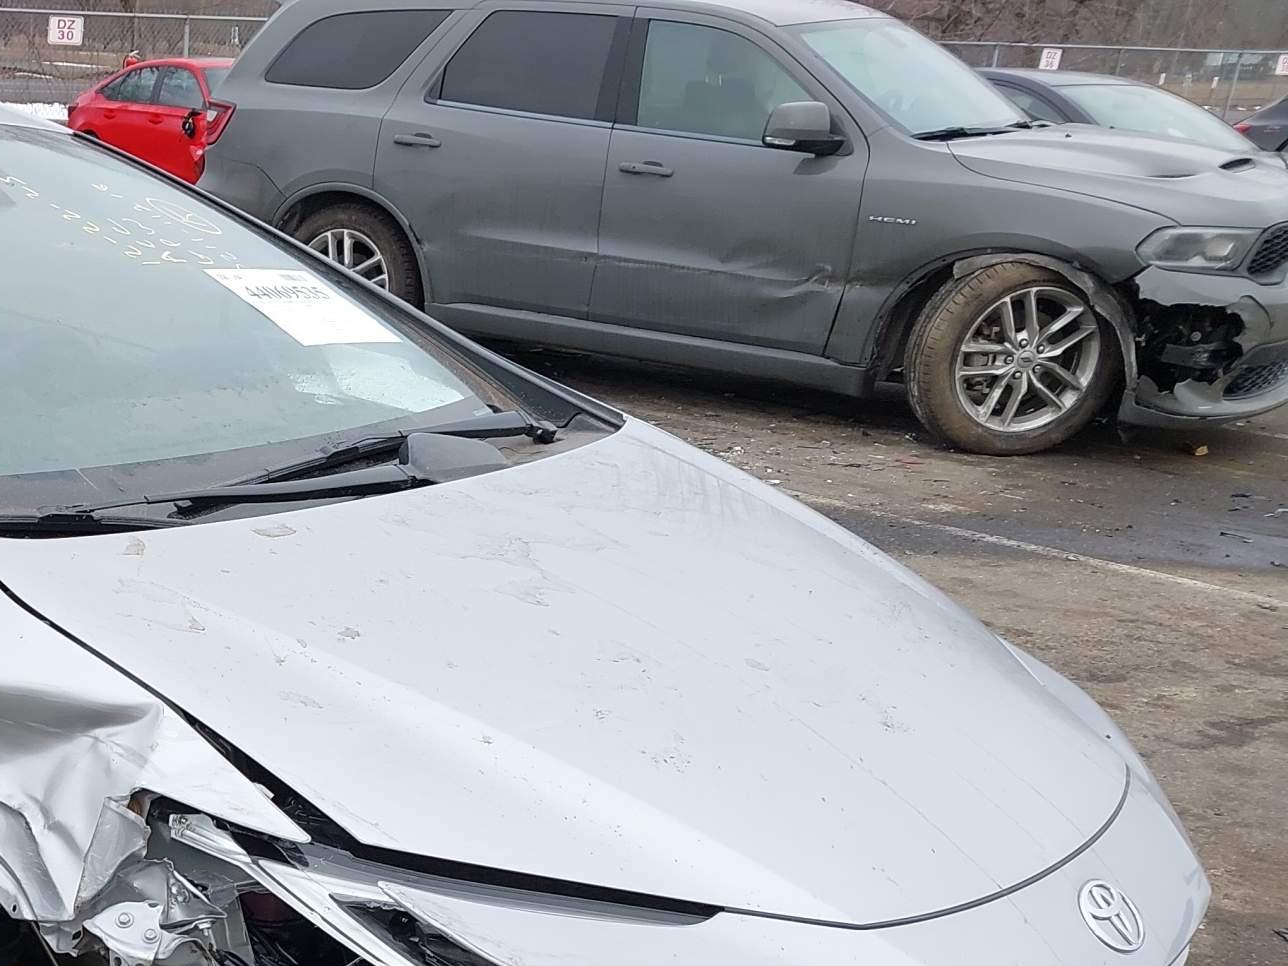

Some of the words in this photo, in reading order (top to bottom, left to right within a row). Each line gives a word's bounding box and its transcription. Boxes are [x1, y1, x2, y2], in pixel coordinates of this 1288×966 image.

[57, 19, 76, 30] DZ
[57, 30, 74, 41] 30
[869, 215, 917, 225] HEMI
[245, 286, 330, 300] 44069535
